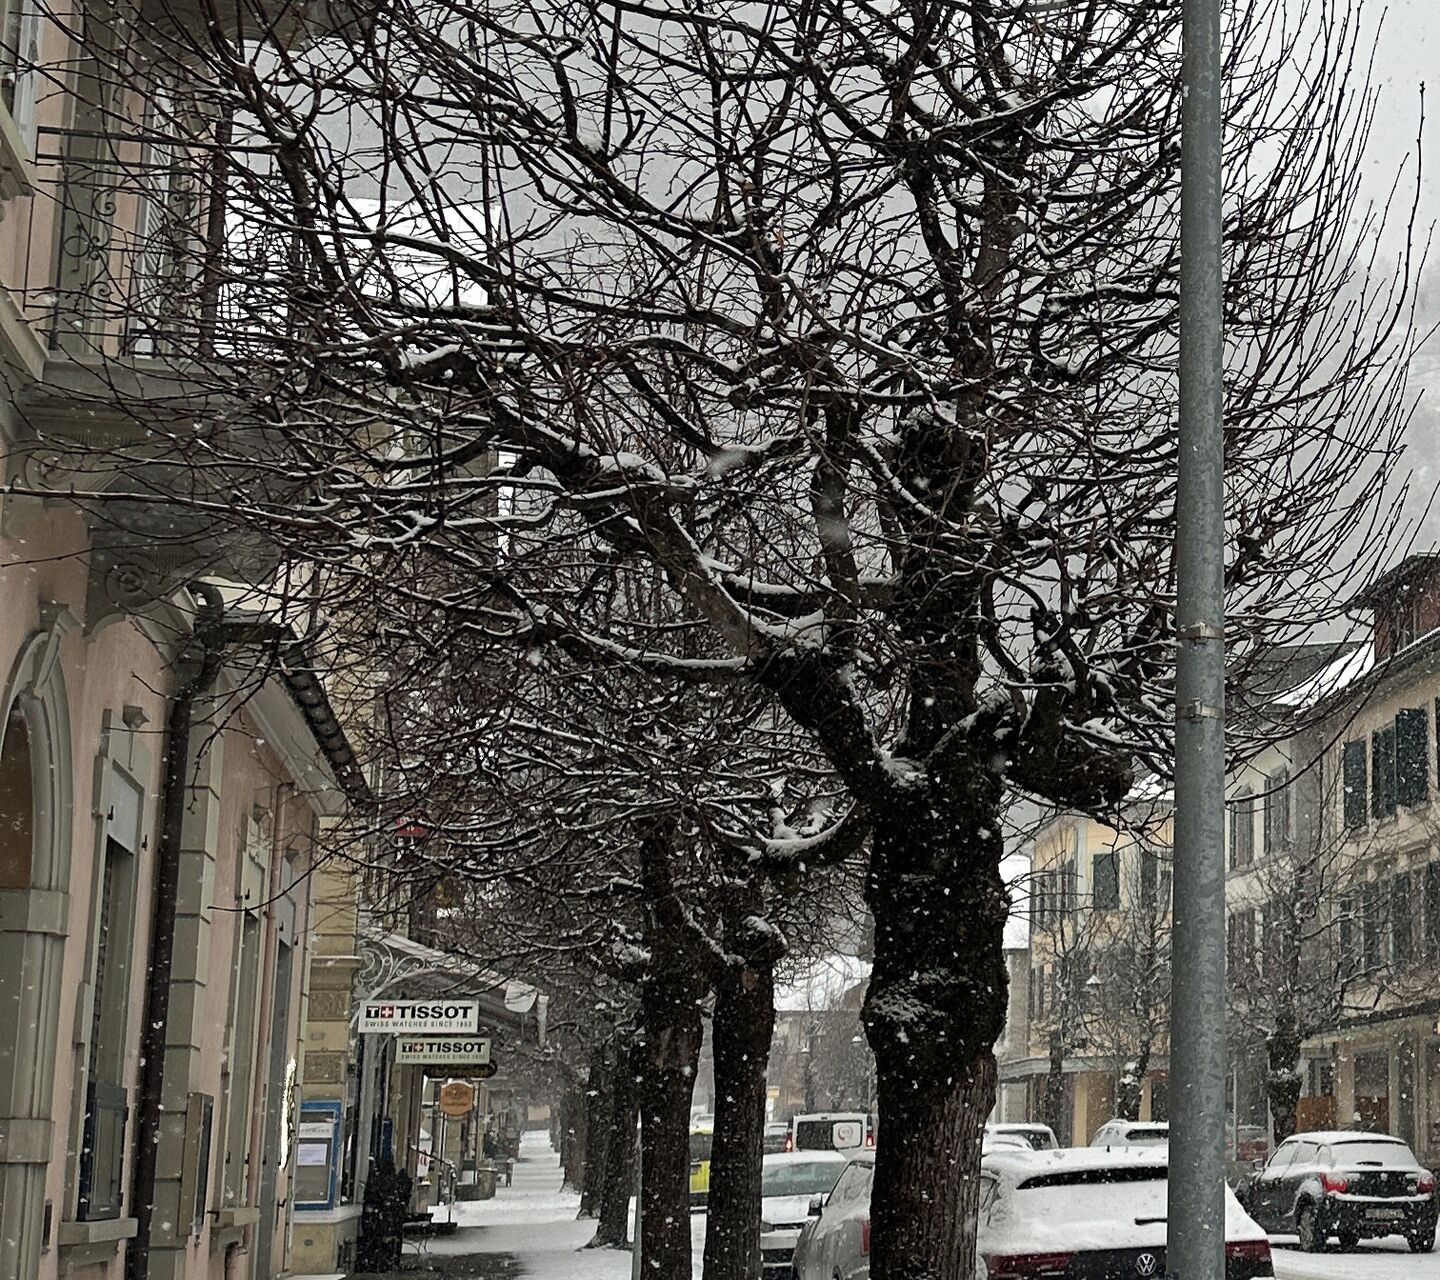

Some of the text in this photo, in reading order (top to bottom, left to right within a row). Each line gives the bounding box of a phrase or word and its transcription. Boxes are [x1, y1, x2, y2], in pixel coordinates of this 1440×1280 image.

[396, 1006, 473, 1019] TISSOT
[365, 1020, 389, 1028] SWISS
[392, 1020, 427, 1028] WATCHES
[431, 1020, 452, 1028] SINCE
[426, 1042, 485, 1053] TISSOT
